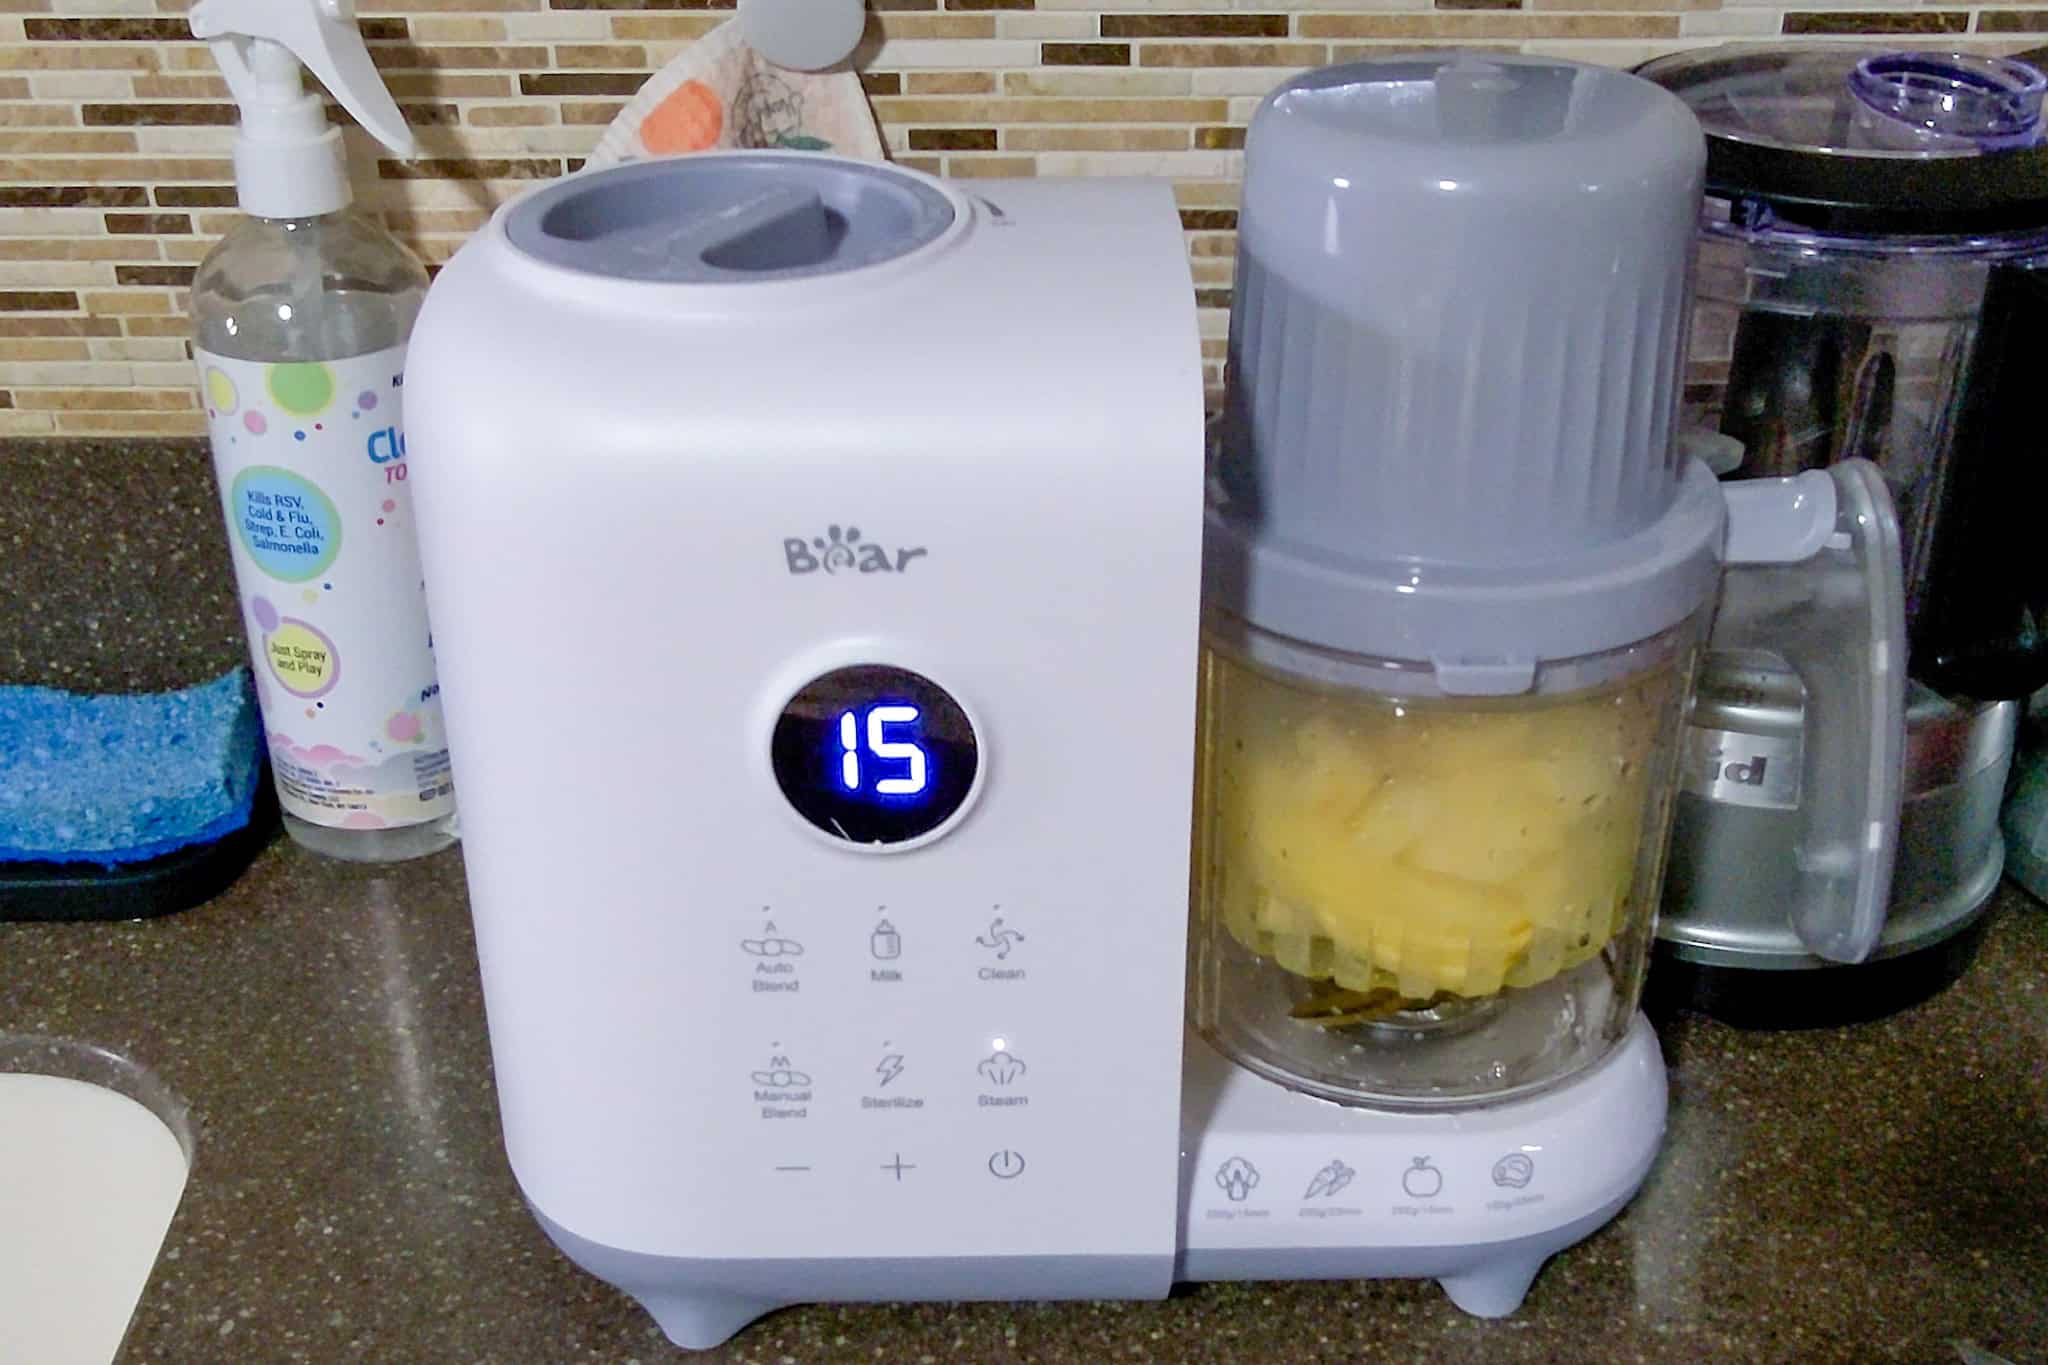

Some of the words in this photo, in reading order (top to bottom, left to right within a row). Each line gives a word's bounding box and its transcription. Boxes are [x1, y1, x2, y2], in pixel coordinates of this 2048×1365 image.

[367, 425, 406, 464] Cl
[247, 490, 272, 506] Kills
[248, 505, 273, 521] Cold
[276, 510, 285, 522] &
[253, 535, 319, 555] Salmonella
[271, 641, 291, 656] Just
[293, 646, 326, 664] Spray
[276, 659, 296, 671] and
[297, 660, 322, 677] Play
[840, 706, 926, 794] 15
[755, 961, 794, 974] Auto
[977, 967, 1026, 981] Clean
[870, 968, 903, 982] Milk
[752, 979, 800, 993] Blend
[753, 1089, 812, 1102] Manual
[861, 1096, 924, 1109] Sterilize
[977, 1093, 1029, 1107] Steam
[762, 1107, 807, 1120] Blend
